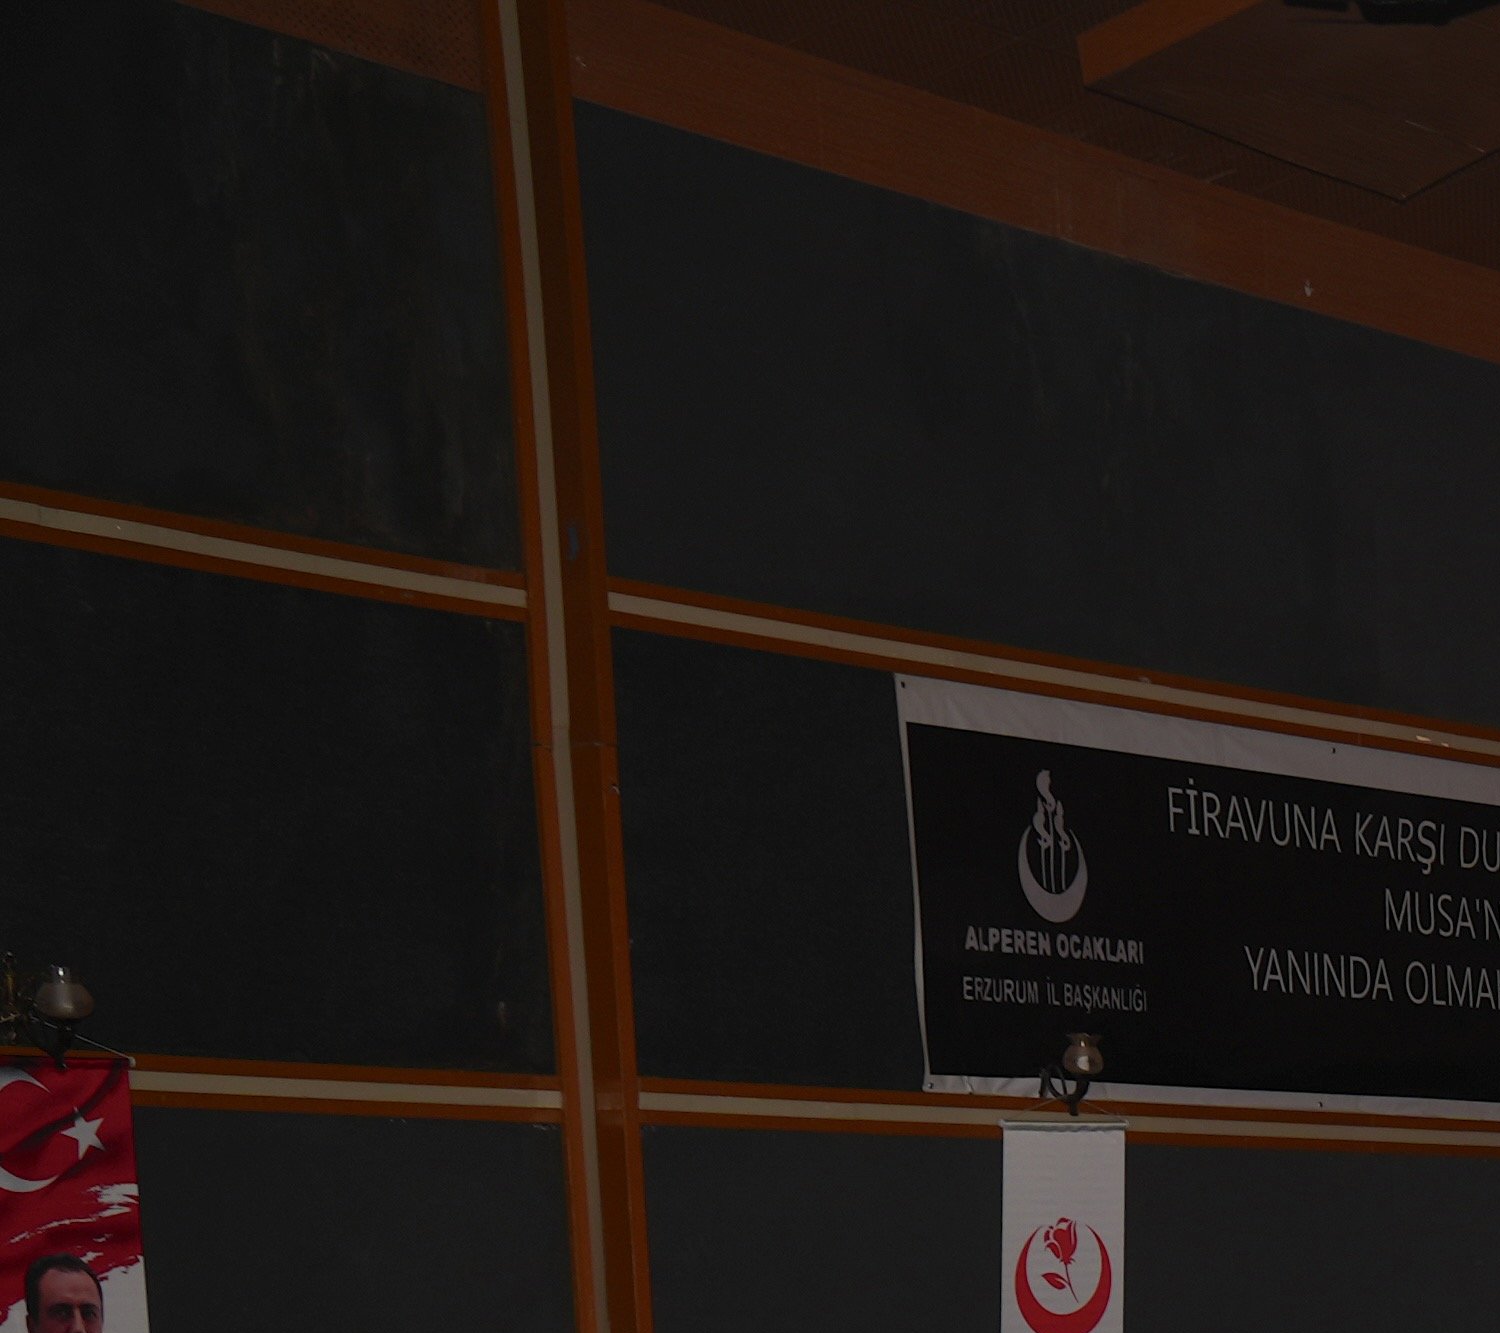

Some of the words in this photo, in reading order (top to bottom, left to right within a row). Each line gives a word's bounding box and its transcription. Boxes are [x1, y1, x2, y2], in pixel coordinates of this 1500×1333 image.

[1168, 778, 1341, 853] FİRAVUNA
[1355, 812, 1445, 875] KARŞI
[965, 925, 1051, 956] ALPEREN
[1056, 933, 1144, 964] OCAKLARI
[962, 976, 1039, 1004] ERZURUM
[1046, 976, 1061, 1006] İL
[1064, 983, 1147, 1014] BAŞKANLIĞI
[1244, 945, 1393, 1001] YANINDA
